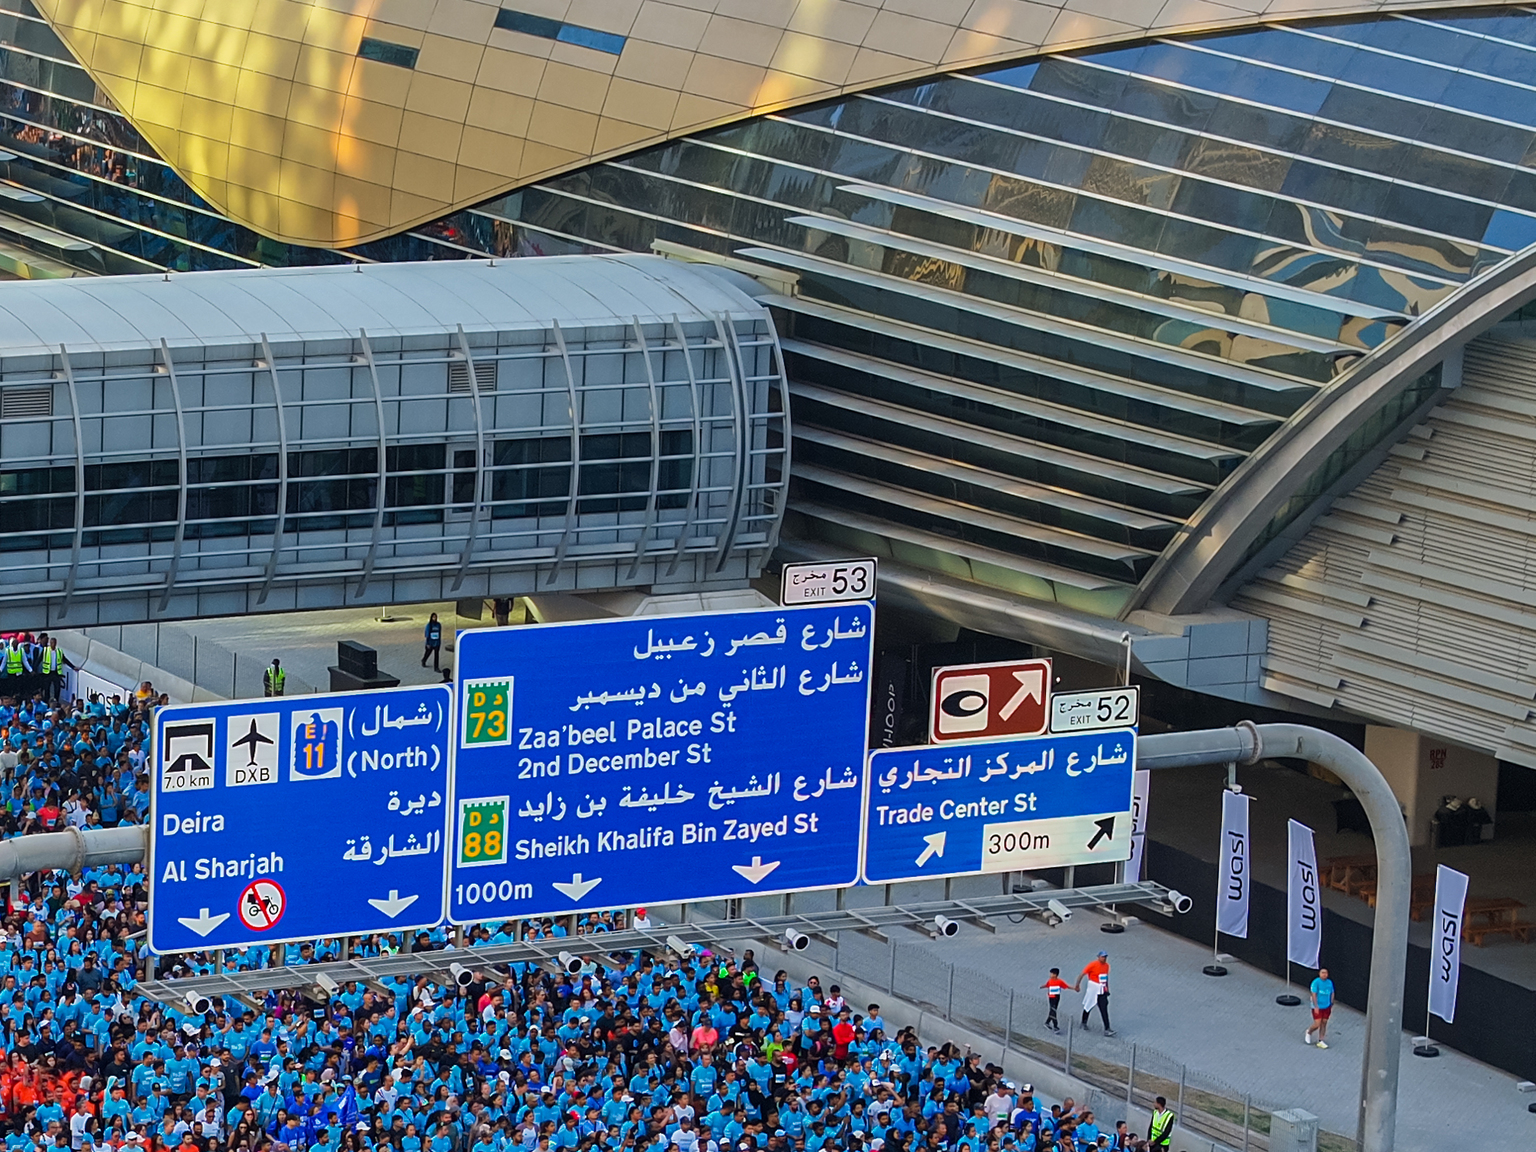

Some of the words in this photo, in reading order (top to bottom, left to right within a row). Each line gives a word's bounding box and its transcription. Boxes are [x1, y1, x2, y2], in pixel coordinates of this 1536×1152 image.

[791, 571, 827, 585] مخرج
[804, 587, 826, 598] EXIT
[831, 566, 868, 595] 53
[633, 629, 715, 660] زعبيل
[724, 617, 787, 656] قصر
[800, 615, 867, 651] شارع
[669, 678, 707, 703] من
[718, 664, 786, 708] الثاني
[798, 661, 864, 696] شارع
[472, 691, 486, 708] D
[568, 680, 661, 712] ديسمبر
[1058, 698, 1092, 714] مخرج
[1096, 694, 1131, 723] 52
[469, 709, 506, 739] 73
[627, 716, 703, 742] Palace
[710, 710, 737, 734] St
[1070, 715, 1091, 726] EXIT
[303, 742, 325, 770] 11
[347, 743, 441, 779] (North)
[517, 754, 561, 780] 2nd
[568, 747, 681, 776] December
[686, 742, 712, 765] St
[978, 747, 1055, 782] المركز
[1065, 742, 1128, 778] شارع
[164, 775, 186, 790] 7.0
[189, 775, 210, 787] km
[235, 767, 270, 784] DXB
[708, 771, 782, 810] الشيخ
[792, 766, 858, 801] شارع
[878, 754, 972, 795] التجاري
[387, 790, 442, 817] ديرة
[517, 791, 567, 823] زايد
[575, 793, 608, 820] بن
[618, 781, 696, 813] خليفة
[876, 803, 934, 827] Trade
[939, 796, 1010, 821] Center
[1013, 792, 1038, 813] St
[163, 810, 226, 837] Deira
[469, 810, 483, 827] D
[342, 829, 441, 866] الشارقة
[463, 830, 502, 859] 88
[514, 833, 590, 861] Sheikh
[597, 825, 675, 854] Khalifa
[681, 821, 718, 846] Bin
[722, 814, 788, 845] Zayed
[793, 812, 820, 835] St
[988, 831, 1051, 855] 300m
[162, 860, 188, 884] Al
[194, 850, 285, 880] Sharjah
[1228, 830, 1245, 901] wasl
[455, 879, 534, 906] 1000m
[1297, 859, 1316, 931] wasl
[1440, 909, 1459, 984] wasl
